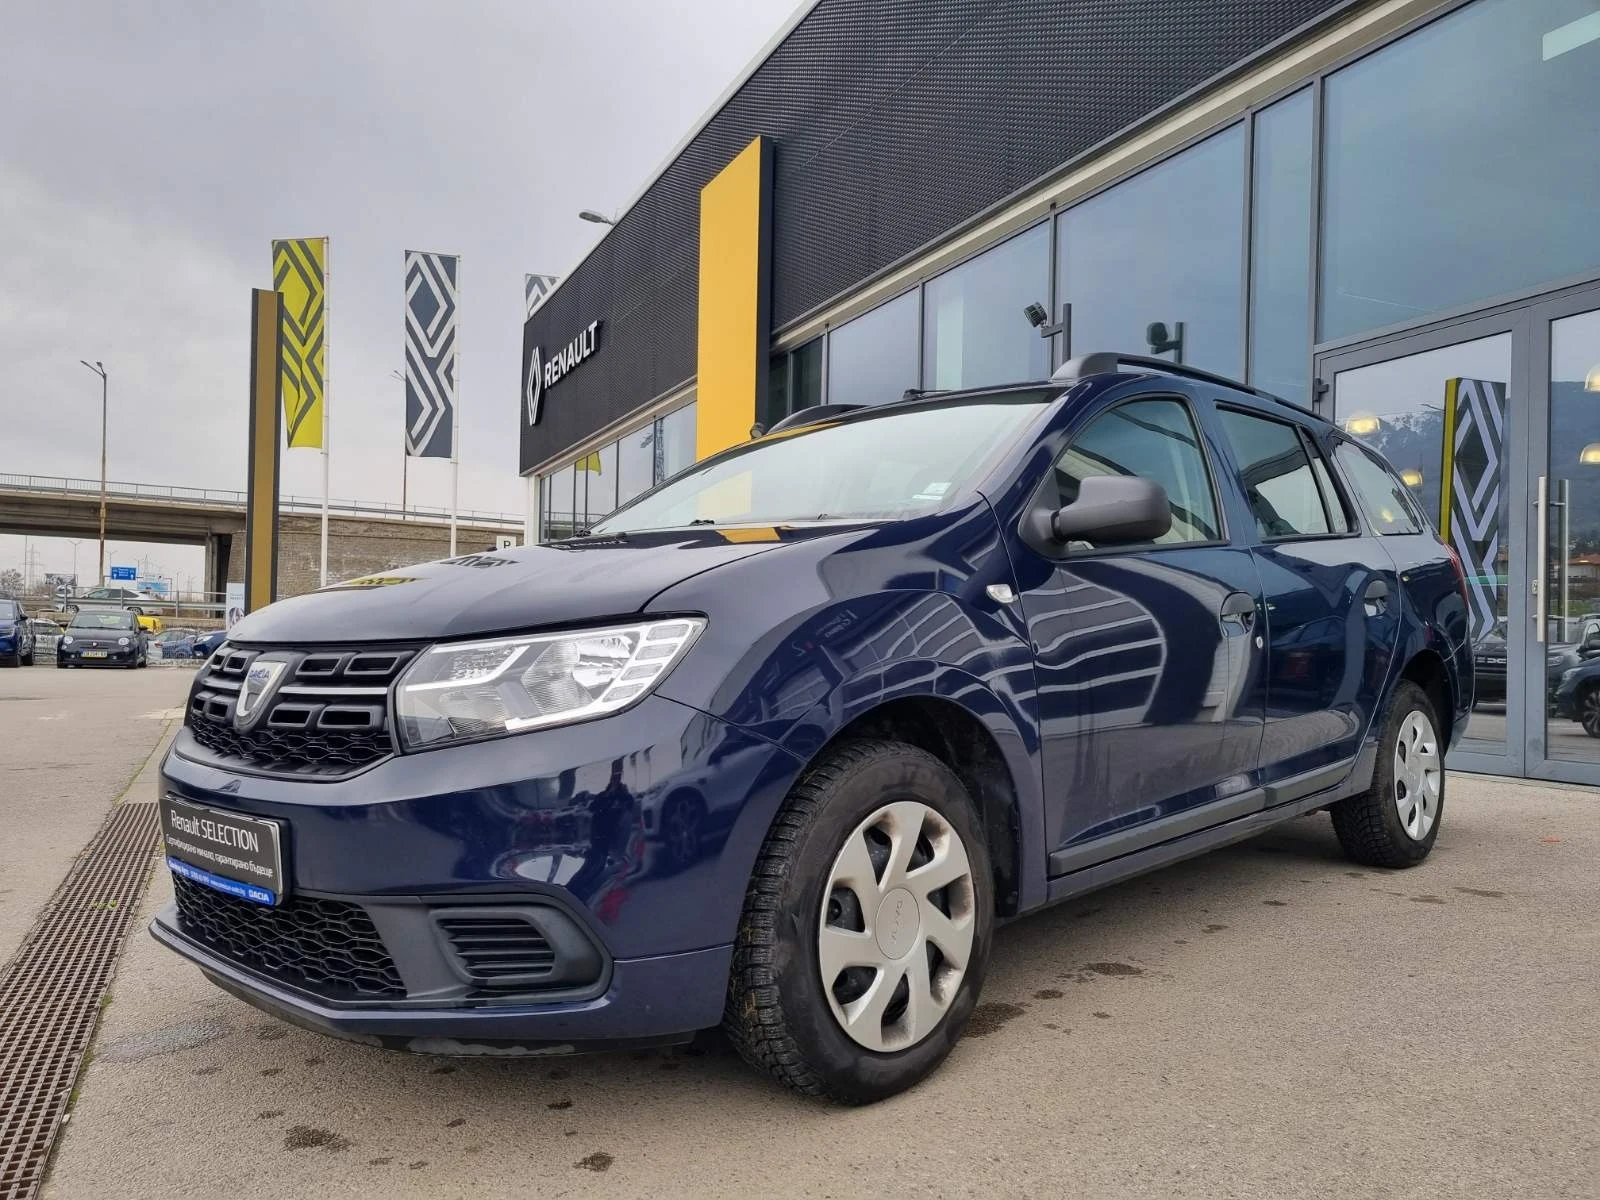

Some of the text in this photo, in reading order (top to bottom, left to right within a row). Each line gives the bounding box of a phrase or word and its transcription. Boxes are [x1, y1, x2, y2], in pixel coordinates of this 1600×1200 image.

[544, 320, 598, 389] RENAULT
[503, 540, 511, 549] P
[170, 809, 259, 853] Renault SELECTION
